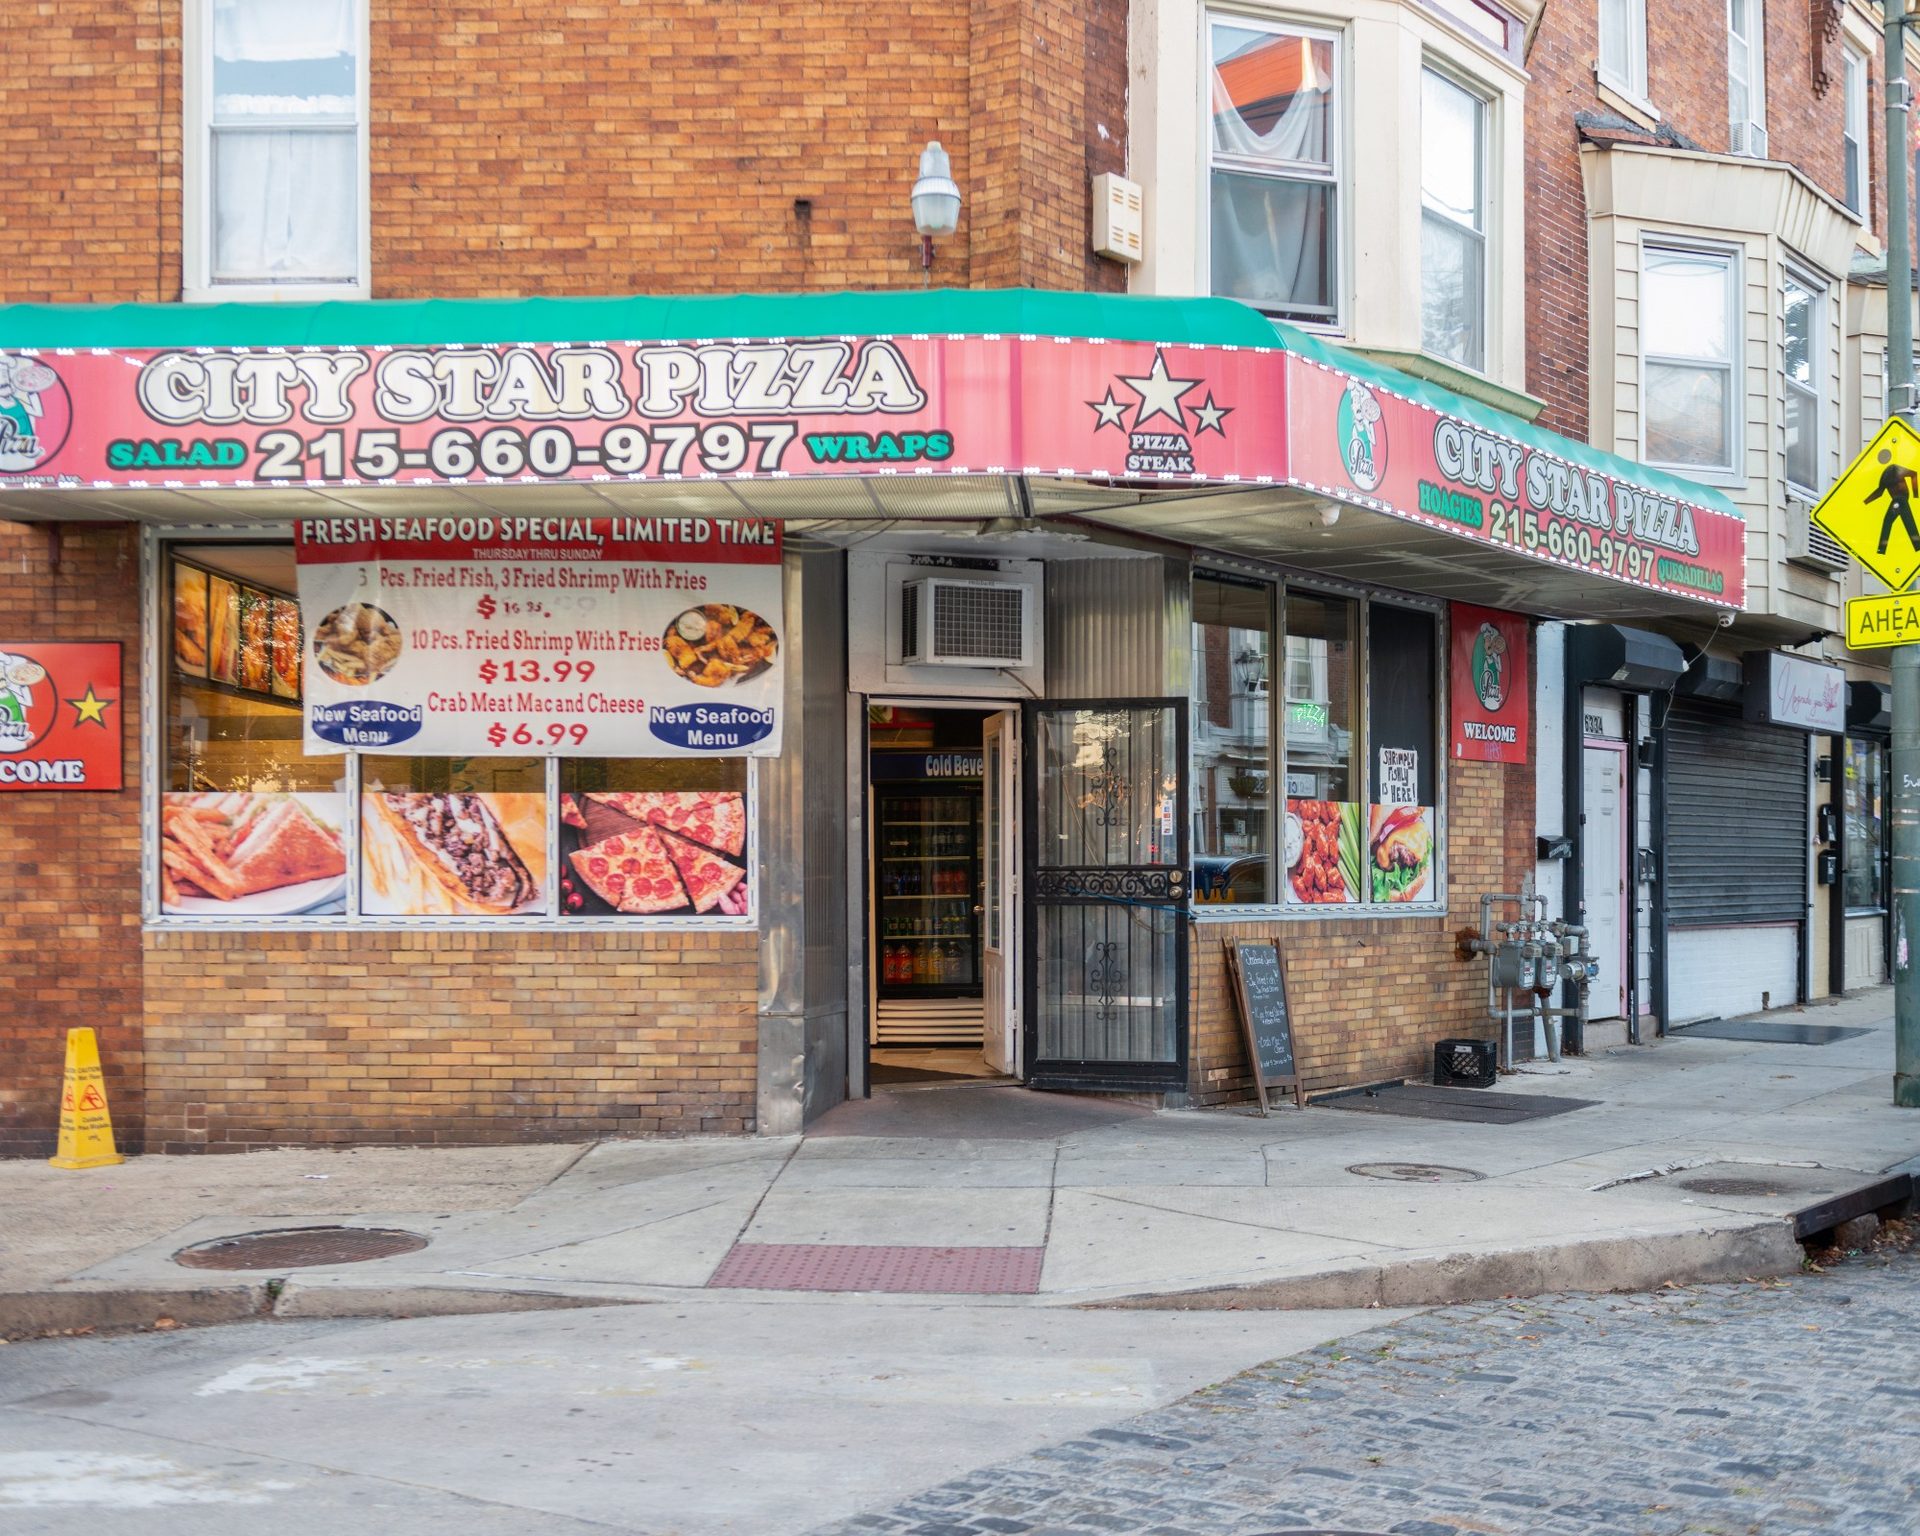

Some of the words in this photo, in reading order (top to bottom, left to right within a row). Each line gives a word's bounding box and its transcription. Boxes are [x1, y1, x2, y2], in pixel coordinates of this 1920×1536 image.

[138, 350, 370, 425] CITY
[376, 345, 630, 423] STAR
[634, 339, 927, 418] PIZZA
[107, 437, 248, 470] SALAD
[254, 421, 798, 480] 215-660-9797
[804, 430, 954, 463] WRAPS
[1129, 431, 1192, 452] PIZZA
[1125, 453, 1195, 474] STEAK
[1348, 438, 1378, 482] Pizza
[1434, 418, 1523, 500] CITY
[1525, 453, 1612, 531] STAR
[1613, 480, 1699, 556] PIZZA
[302, 518, 377, 544] FRESH
[379, 517, 495, 542] SEAFOOD
[499, 517, 605, 545] SPECIAL,
[611, 518, 712, 543] LIMITED
[716, 519, 777, 545] TIME
[1418, 480, 1483, 529] HOAGIES
[1489, 500, 1655, 581] 215-660-9797
[1657, 556, 1724, 595] QUESADILLAS
[472, 548, 529, 560] THURSDAY
[530, 548, 558, 560] THRU
[560, 549, 603, 560] SUNDAY
[380, 568, 410, 587] Pcs.
[413, 567, 456, 587] Fried
[459, 567, 498, 591] Fish,
[501, 568, 511, 587] 3
[513, 567, 556, 588] Fried
[559, 567, 619, 593] Shrimp
[622, 568, 662, 589] With
[665, 569, 708, 590] Fries
[1860, 606, 1920, 634] AHEA
[412, 631, 429, 650] 10
[431, 630, 463, 650] Pcs.
[466, 630, 511, 650] Fried
[513, 630, 573, 656] Shrimp
[576, 631, 617, 651] With
[619, 631, 660, 651] Fries
[479, 659, 596, 684] $13.99
[313, 705, 347, 722] New
[349, 705, 422, 722] Seafood
[428, 691, 468, 712] Crab
[471, 692, 513, 712] Meat
[516, 692, 553, 713] Mac
[556, 693, 584, 713] and
[587, 693, 645, 713] Cheese
[651, 707, 692, 724] New
[695, 707, 774, 725] Seafood
[342, 728, 389, 743] Menu
[487, 722, 589, 747] $6.99
[687, 730, 739, 745] Menu
[1463, 722, 1516, 742] WELCOME
[0, 759, 85, 783] COME
[926, 755, 952, 776] Cold
[1391, 783, 1416, 803] HERE!
